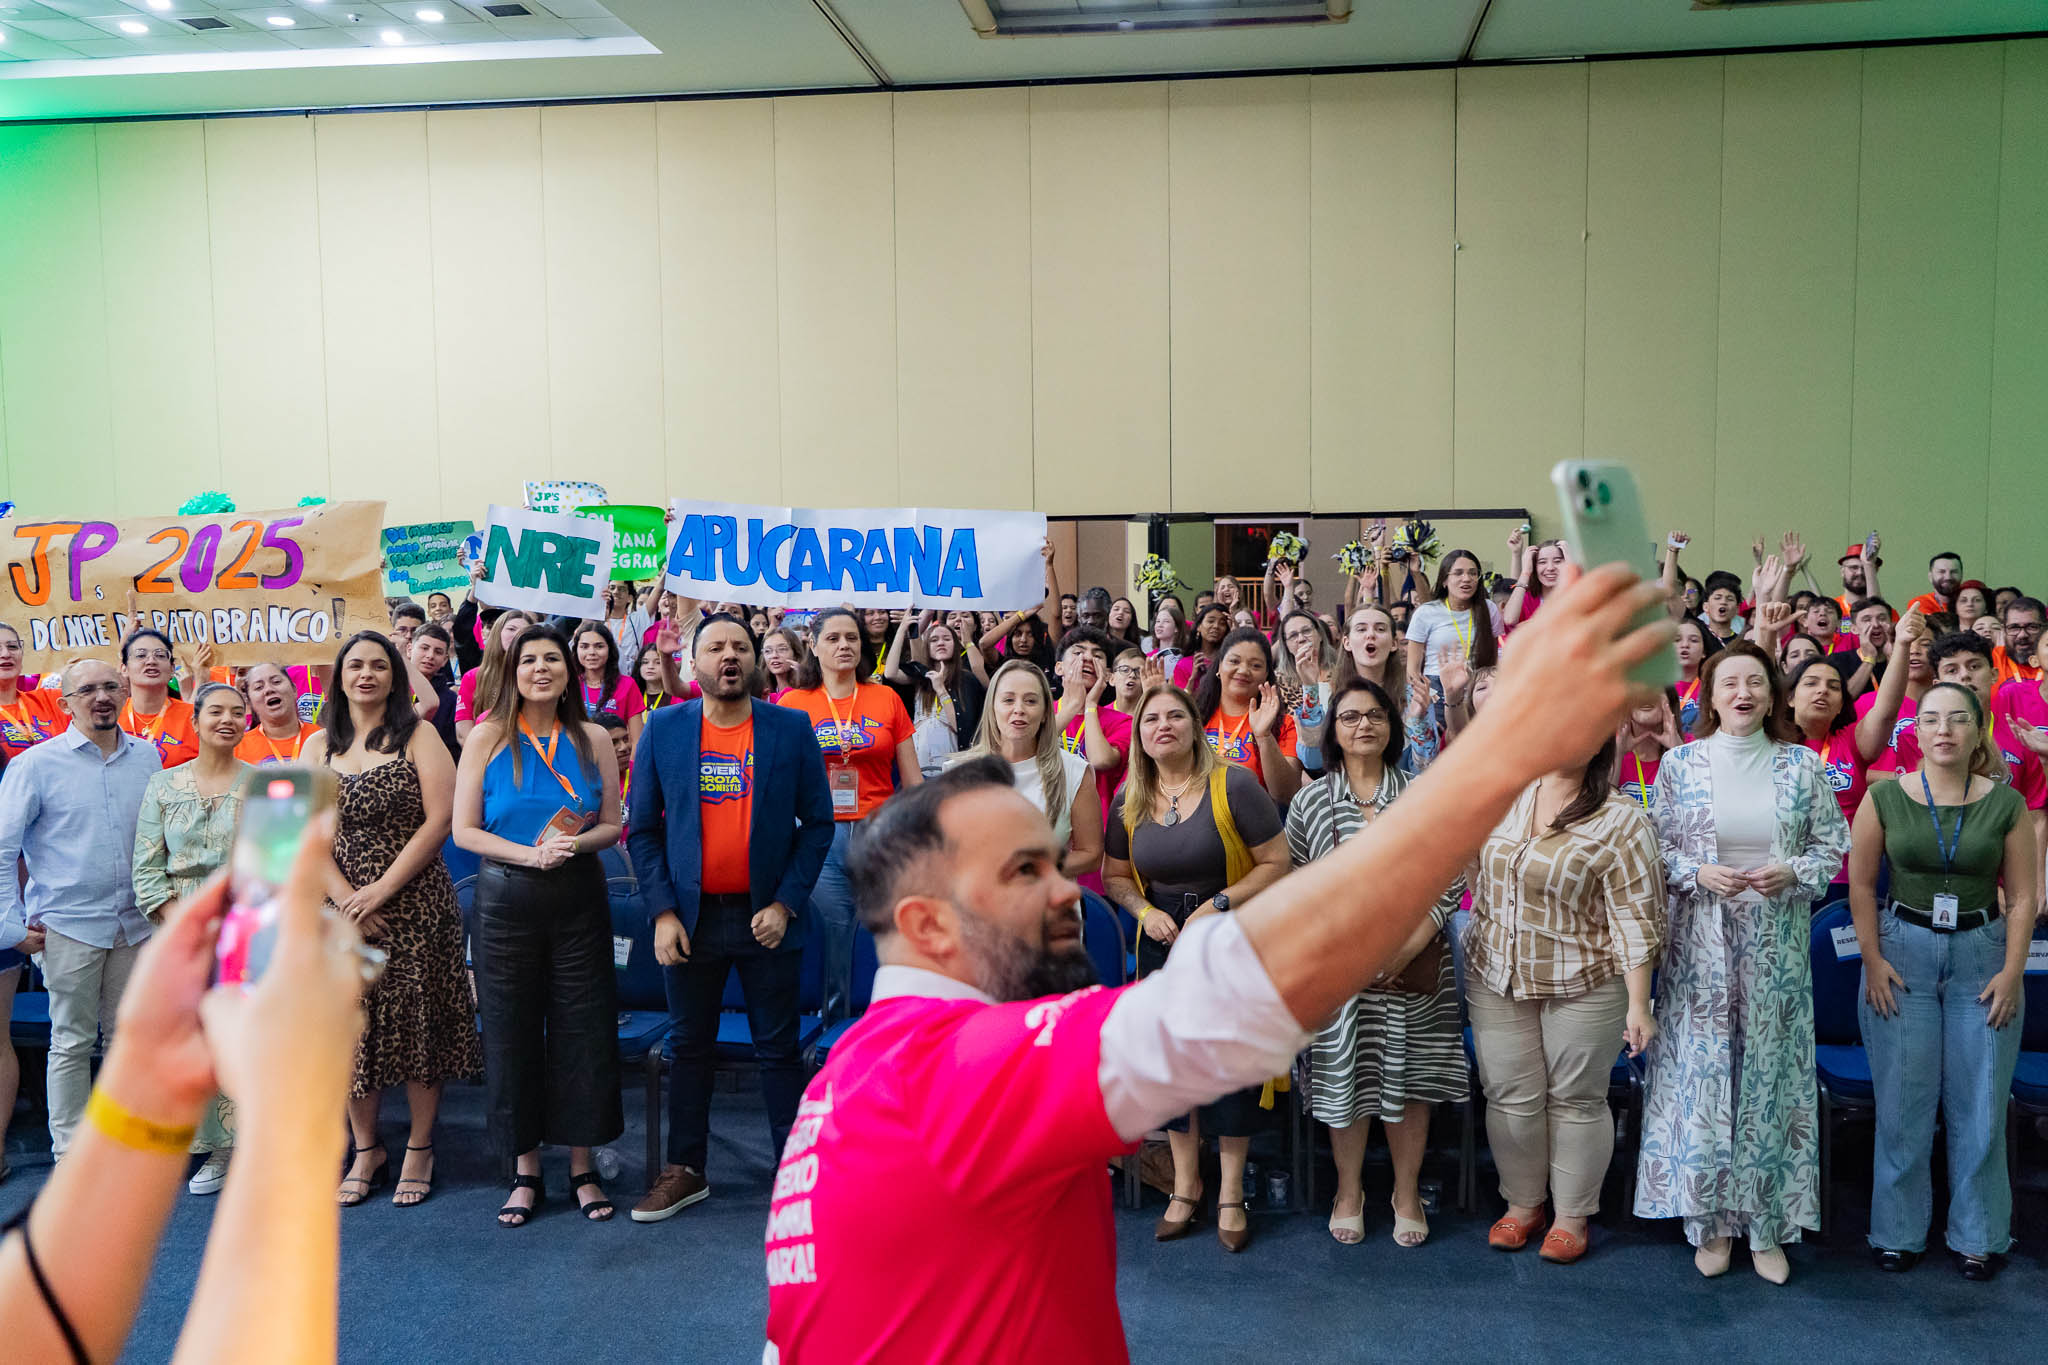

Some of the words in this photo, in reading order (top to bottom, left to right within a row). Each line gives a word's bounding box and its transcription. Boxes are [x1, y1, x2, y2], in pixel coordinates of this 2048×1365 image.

[133, 515, 304, 594] 2025
[485, 524, 601, 599] NRE
[667, 514, 983, 599] APUCARANA
[62, 613, 111, 648] NRE
[151, 609, 208, 644] PATO
[700, 765, 740, 776] OVENS
